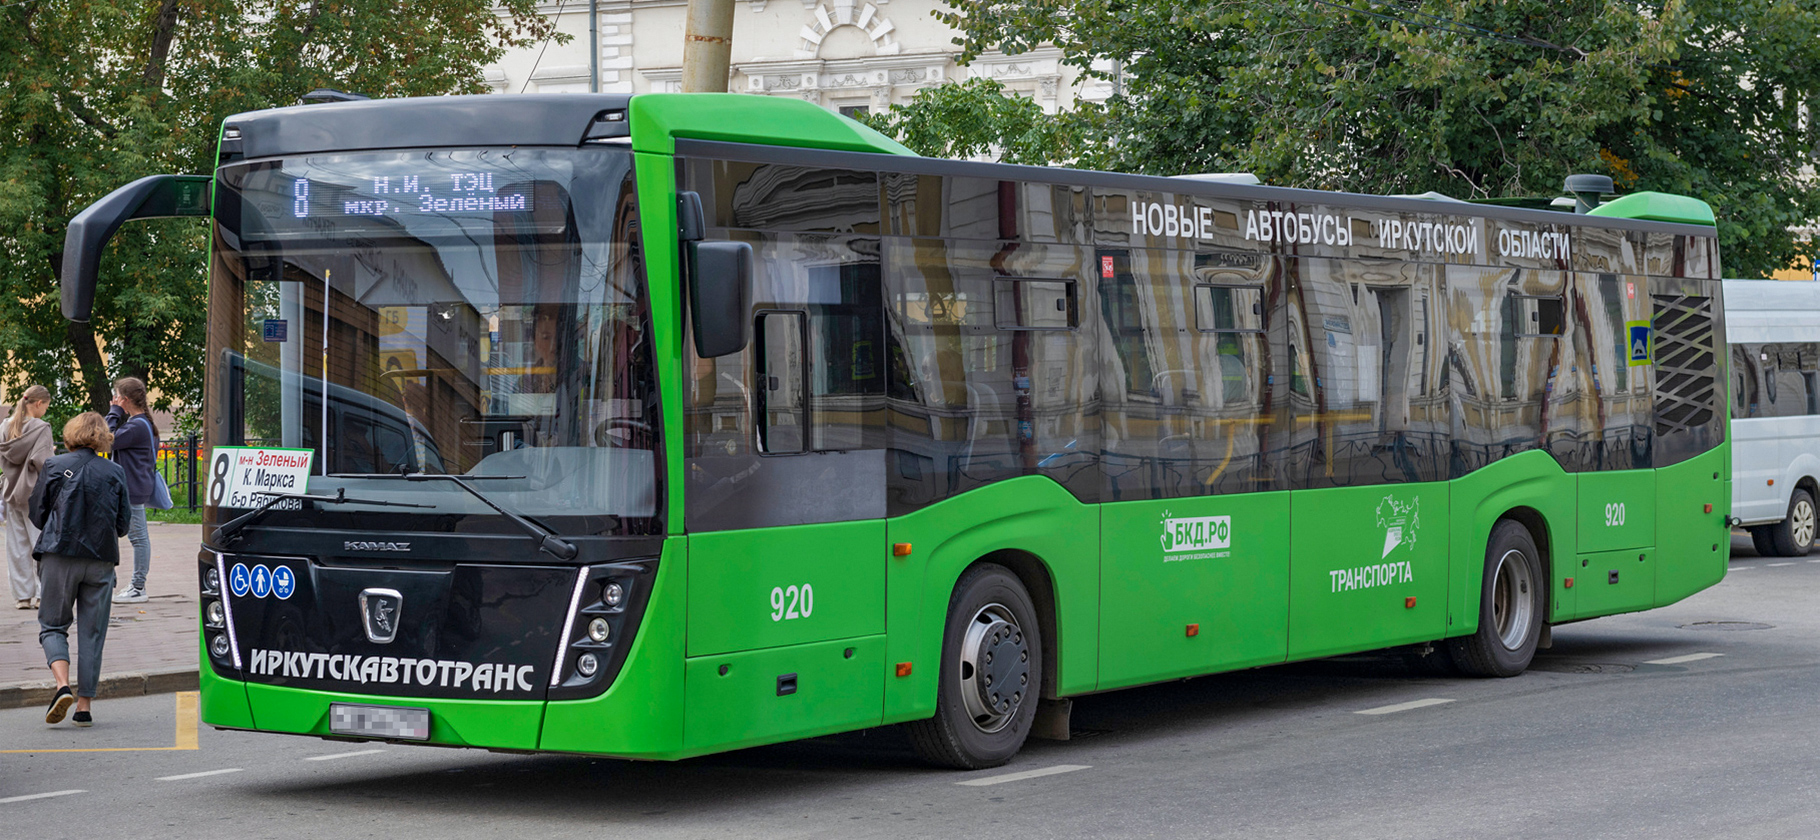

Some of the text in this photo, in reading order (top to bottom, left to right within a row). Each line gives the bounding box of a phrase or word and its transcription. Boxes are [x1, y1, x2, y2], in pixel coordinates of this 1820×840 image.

[374, 172, 494, 194] Н.И. ТЭЦ
[294, 178, 309, 218] 8
[344, 192, 525, 216] мкр. Зелёный
[1131, 201, 1571, 260] НОВЫЕ АВТОБУСЫ ИРКУТСКОЙ ОБЛАСТИ
[239, 450, 309, 468] м-н Зеленый
[210, 452, 230, 507] 8
[242, 467, 295, 491] К. Маркса
[231, 491, 247, 508] б-р
[1605, 502, 1625, 527] 920
[1175, 519, 1228, 547] БКД.РФ
[344, 541, 411, 552] KAMAZ
[1329, 560, 1413, 593] ТРАНСПОРТА
[770, 583, 814, 622] 920
[250, 649, 534, 693] ИРКУТСКАВТОТРАНС
